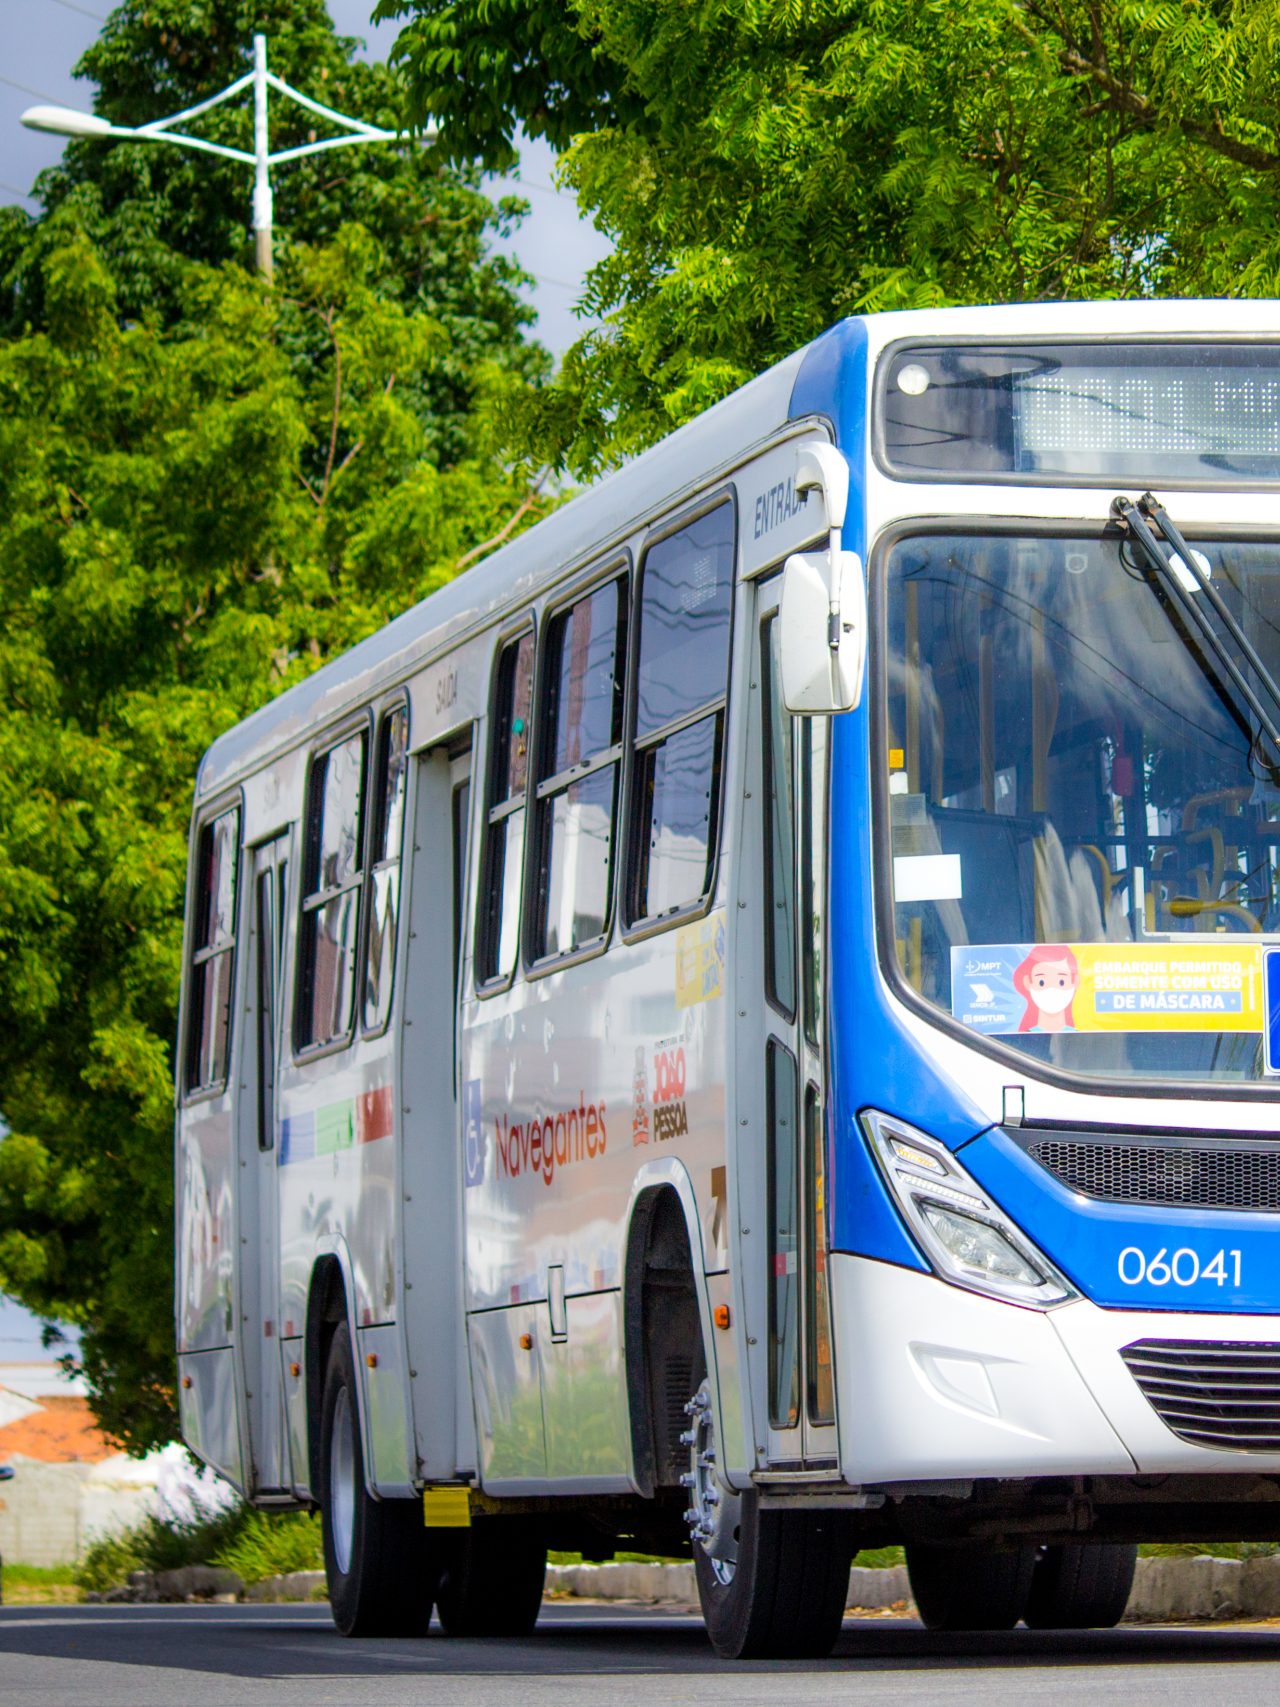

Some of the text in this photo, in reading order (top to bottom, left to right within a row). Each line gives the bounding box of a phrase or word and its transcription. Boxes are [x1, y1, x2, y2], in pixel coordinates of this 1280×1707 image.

[981, 962, 1002, 971] MPT
[1093, 961, 1242, 974] EMBARQUE PERMITIDO
[1093, 976, 1242, 989] SOMENTE COM USO
[1113, 991, 1225, 1009] DE MÁSCARA
[653, 1046, 686, 1104] JOÃO
[653, 1101, 688, 1142] PESSOA
[495, 1089, 607, 1187] Navegantes
[1117, 1247, 1243, 1287] 06041
